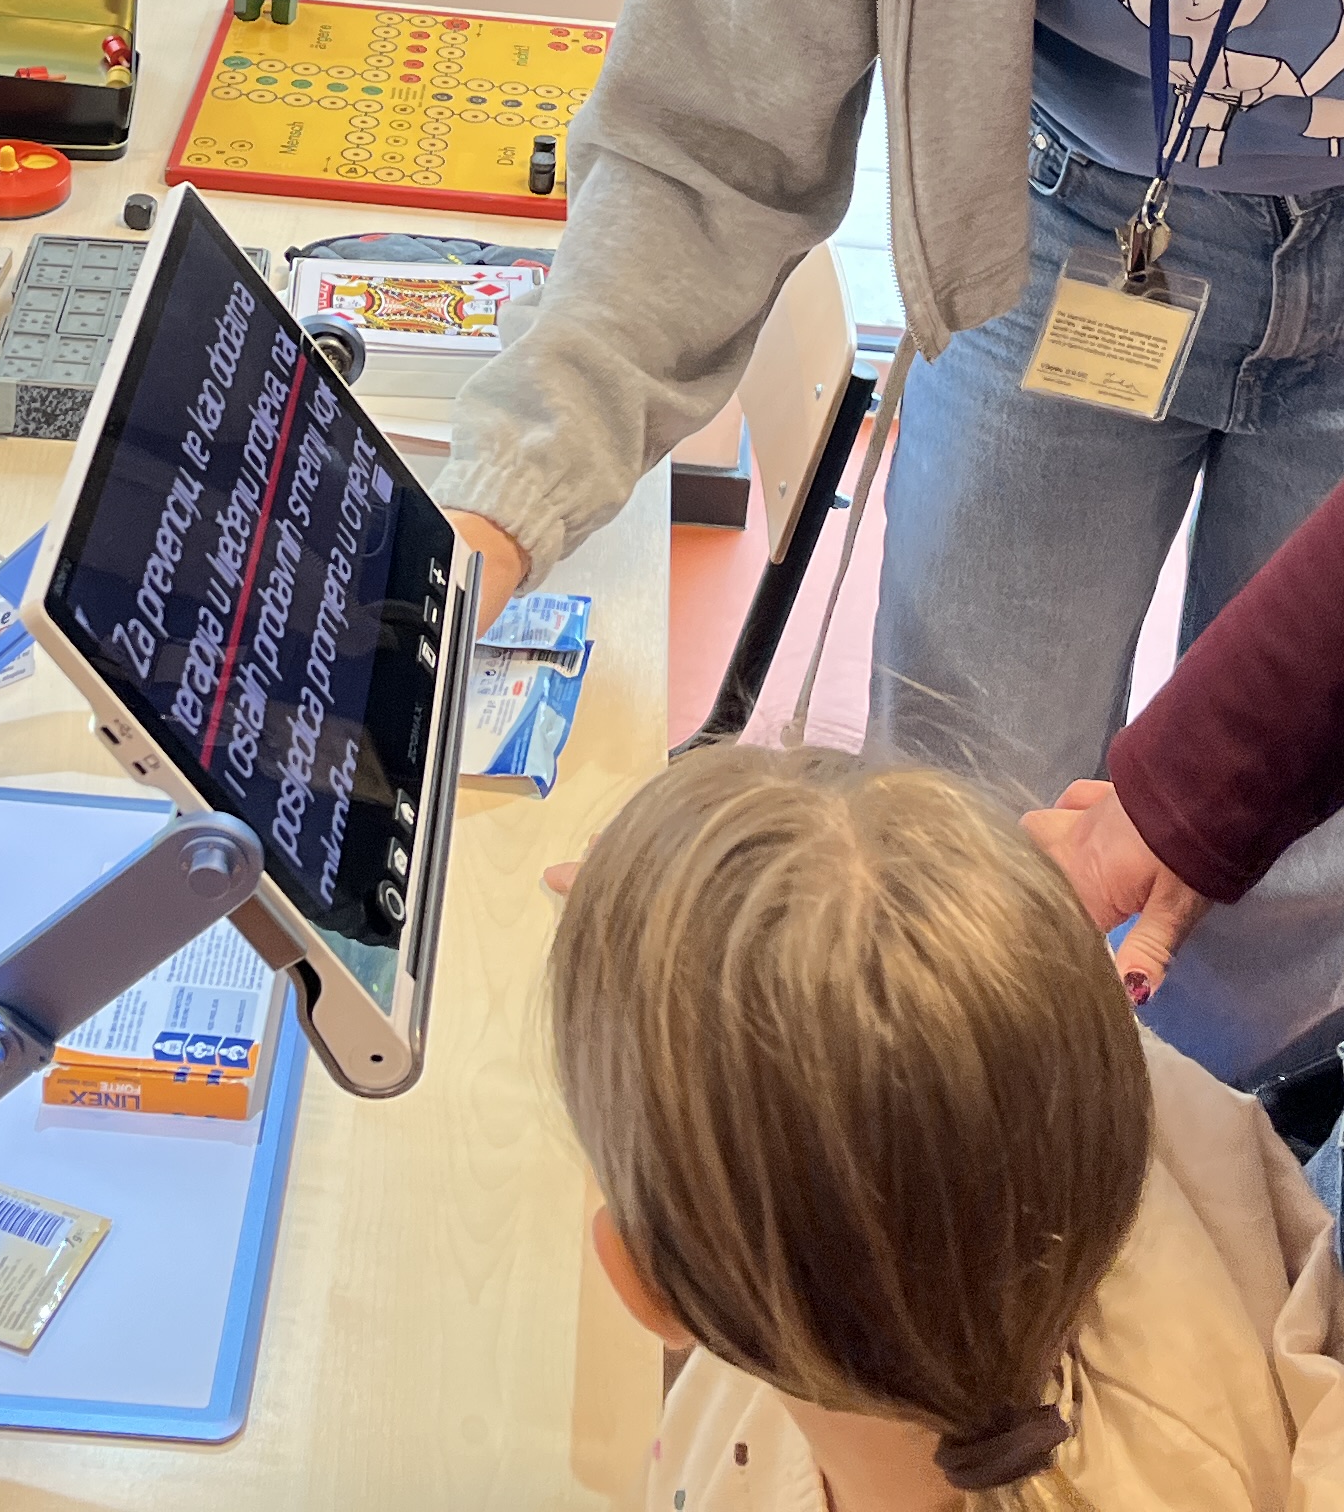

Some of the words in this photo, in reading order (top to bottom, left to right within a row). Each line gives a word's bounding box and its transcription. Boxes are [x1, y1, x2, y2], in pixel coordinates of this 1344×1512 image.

[496, 146, 517, 166] Dich
[205, 280, 255, 388] dodatna
[181, 430, 211, 471] te
[186, 378, 226, 441] kao
[137, 466, 205, 638] prevenciju,
[205, 468, 261, 588] liječenju
[209, 579, 231, 614] u
[228, 662, 271, 778] ostalih
[253, 518, 303, 681] probavnih
[287, 423, 329, 527] smetnji
[111, 618, 155, 679] Za
[171, 605, 225, 736] terapija
[272, 686, 324, 868] posljedica
[306, 546, 352, 704] promjena
[336, 521, 357, 555] u
[69, 1090, 141, 1111] LINEX
